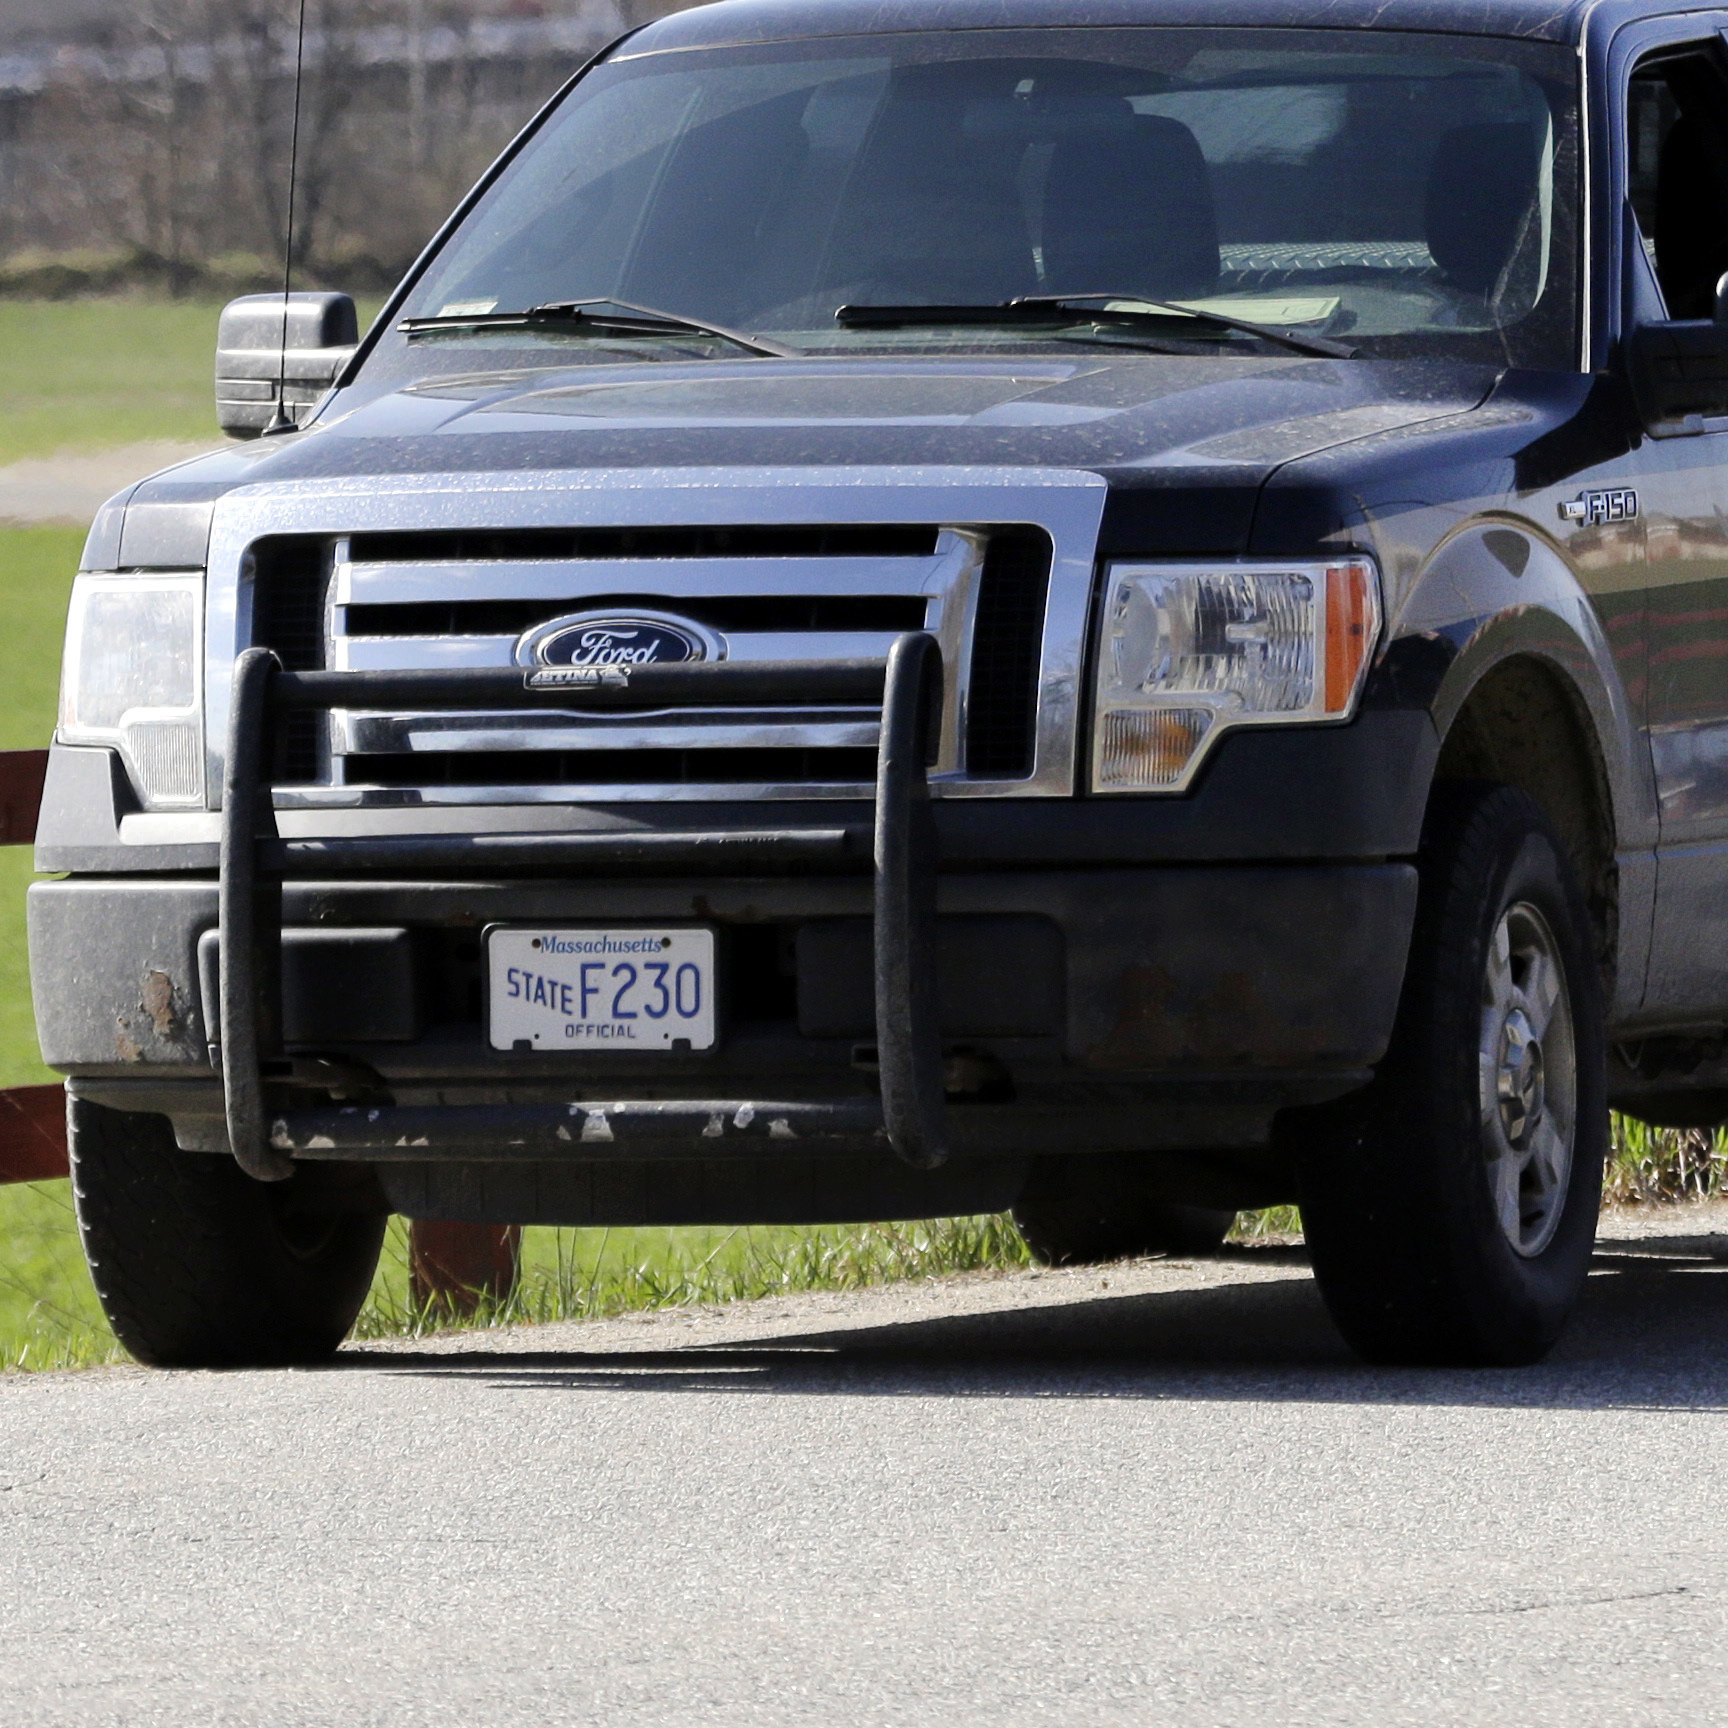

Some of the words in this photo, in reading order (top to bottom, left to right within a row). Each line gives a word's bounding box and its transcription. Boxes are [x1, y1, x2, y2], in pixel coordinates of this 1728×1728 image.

[571, 629, 660, 664] Ford
[540, 936, 662, 954] Massachusetts
[507, 968, 574, 1015] STATE
[580, 962, 701, 1019] F230
[565, 1024, 636, 1039] OFFICIAL
